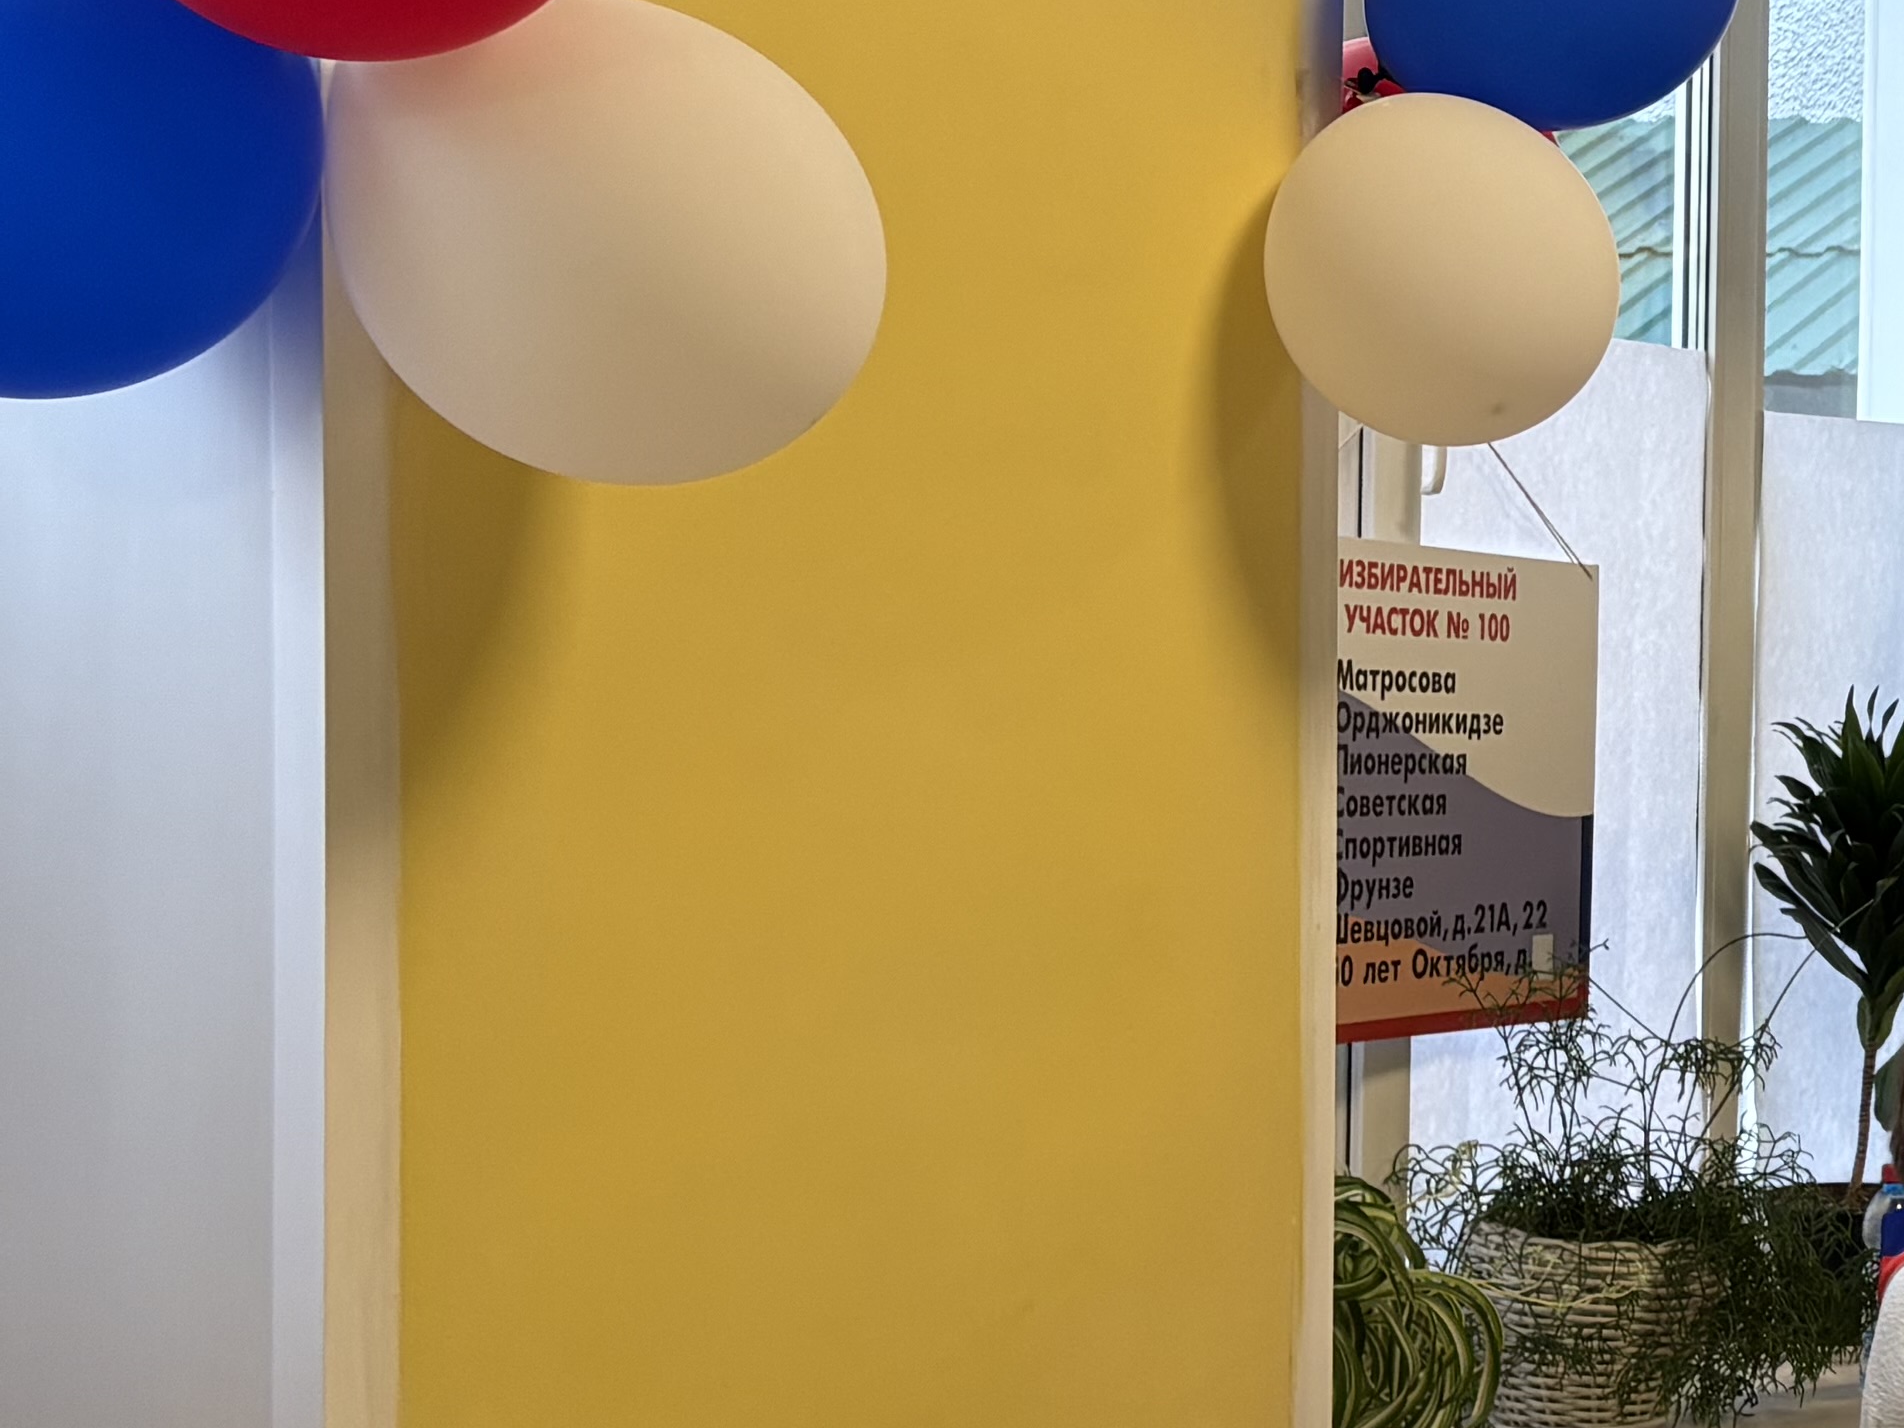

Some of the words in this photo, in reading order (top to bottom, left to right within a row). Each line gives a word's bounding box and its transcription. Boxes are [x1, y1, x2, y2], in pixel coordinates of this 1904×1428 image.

[1339, 558, 1517, 601] ИЗБИРАТЕЛЬНЫЙ
[1344, 603, 1439, 638] УЧАСТОК
[1447, 611, 1469, 639] №
[1478, 613, 1510, 642] 100
[1337, 659, 1456, 700] Матросова
[1337, 701, 1503, 742] Орджоникидзе
[1337, 744, 1467, 783] Пионерская
[1336, 955, 1353, 986] 0
[1364, 959, 1401, 984] лет
